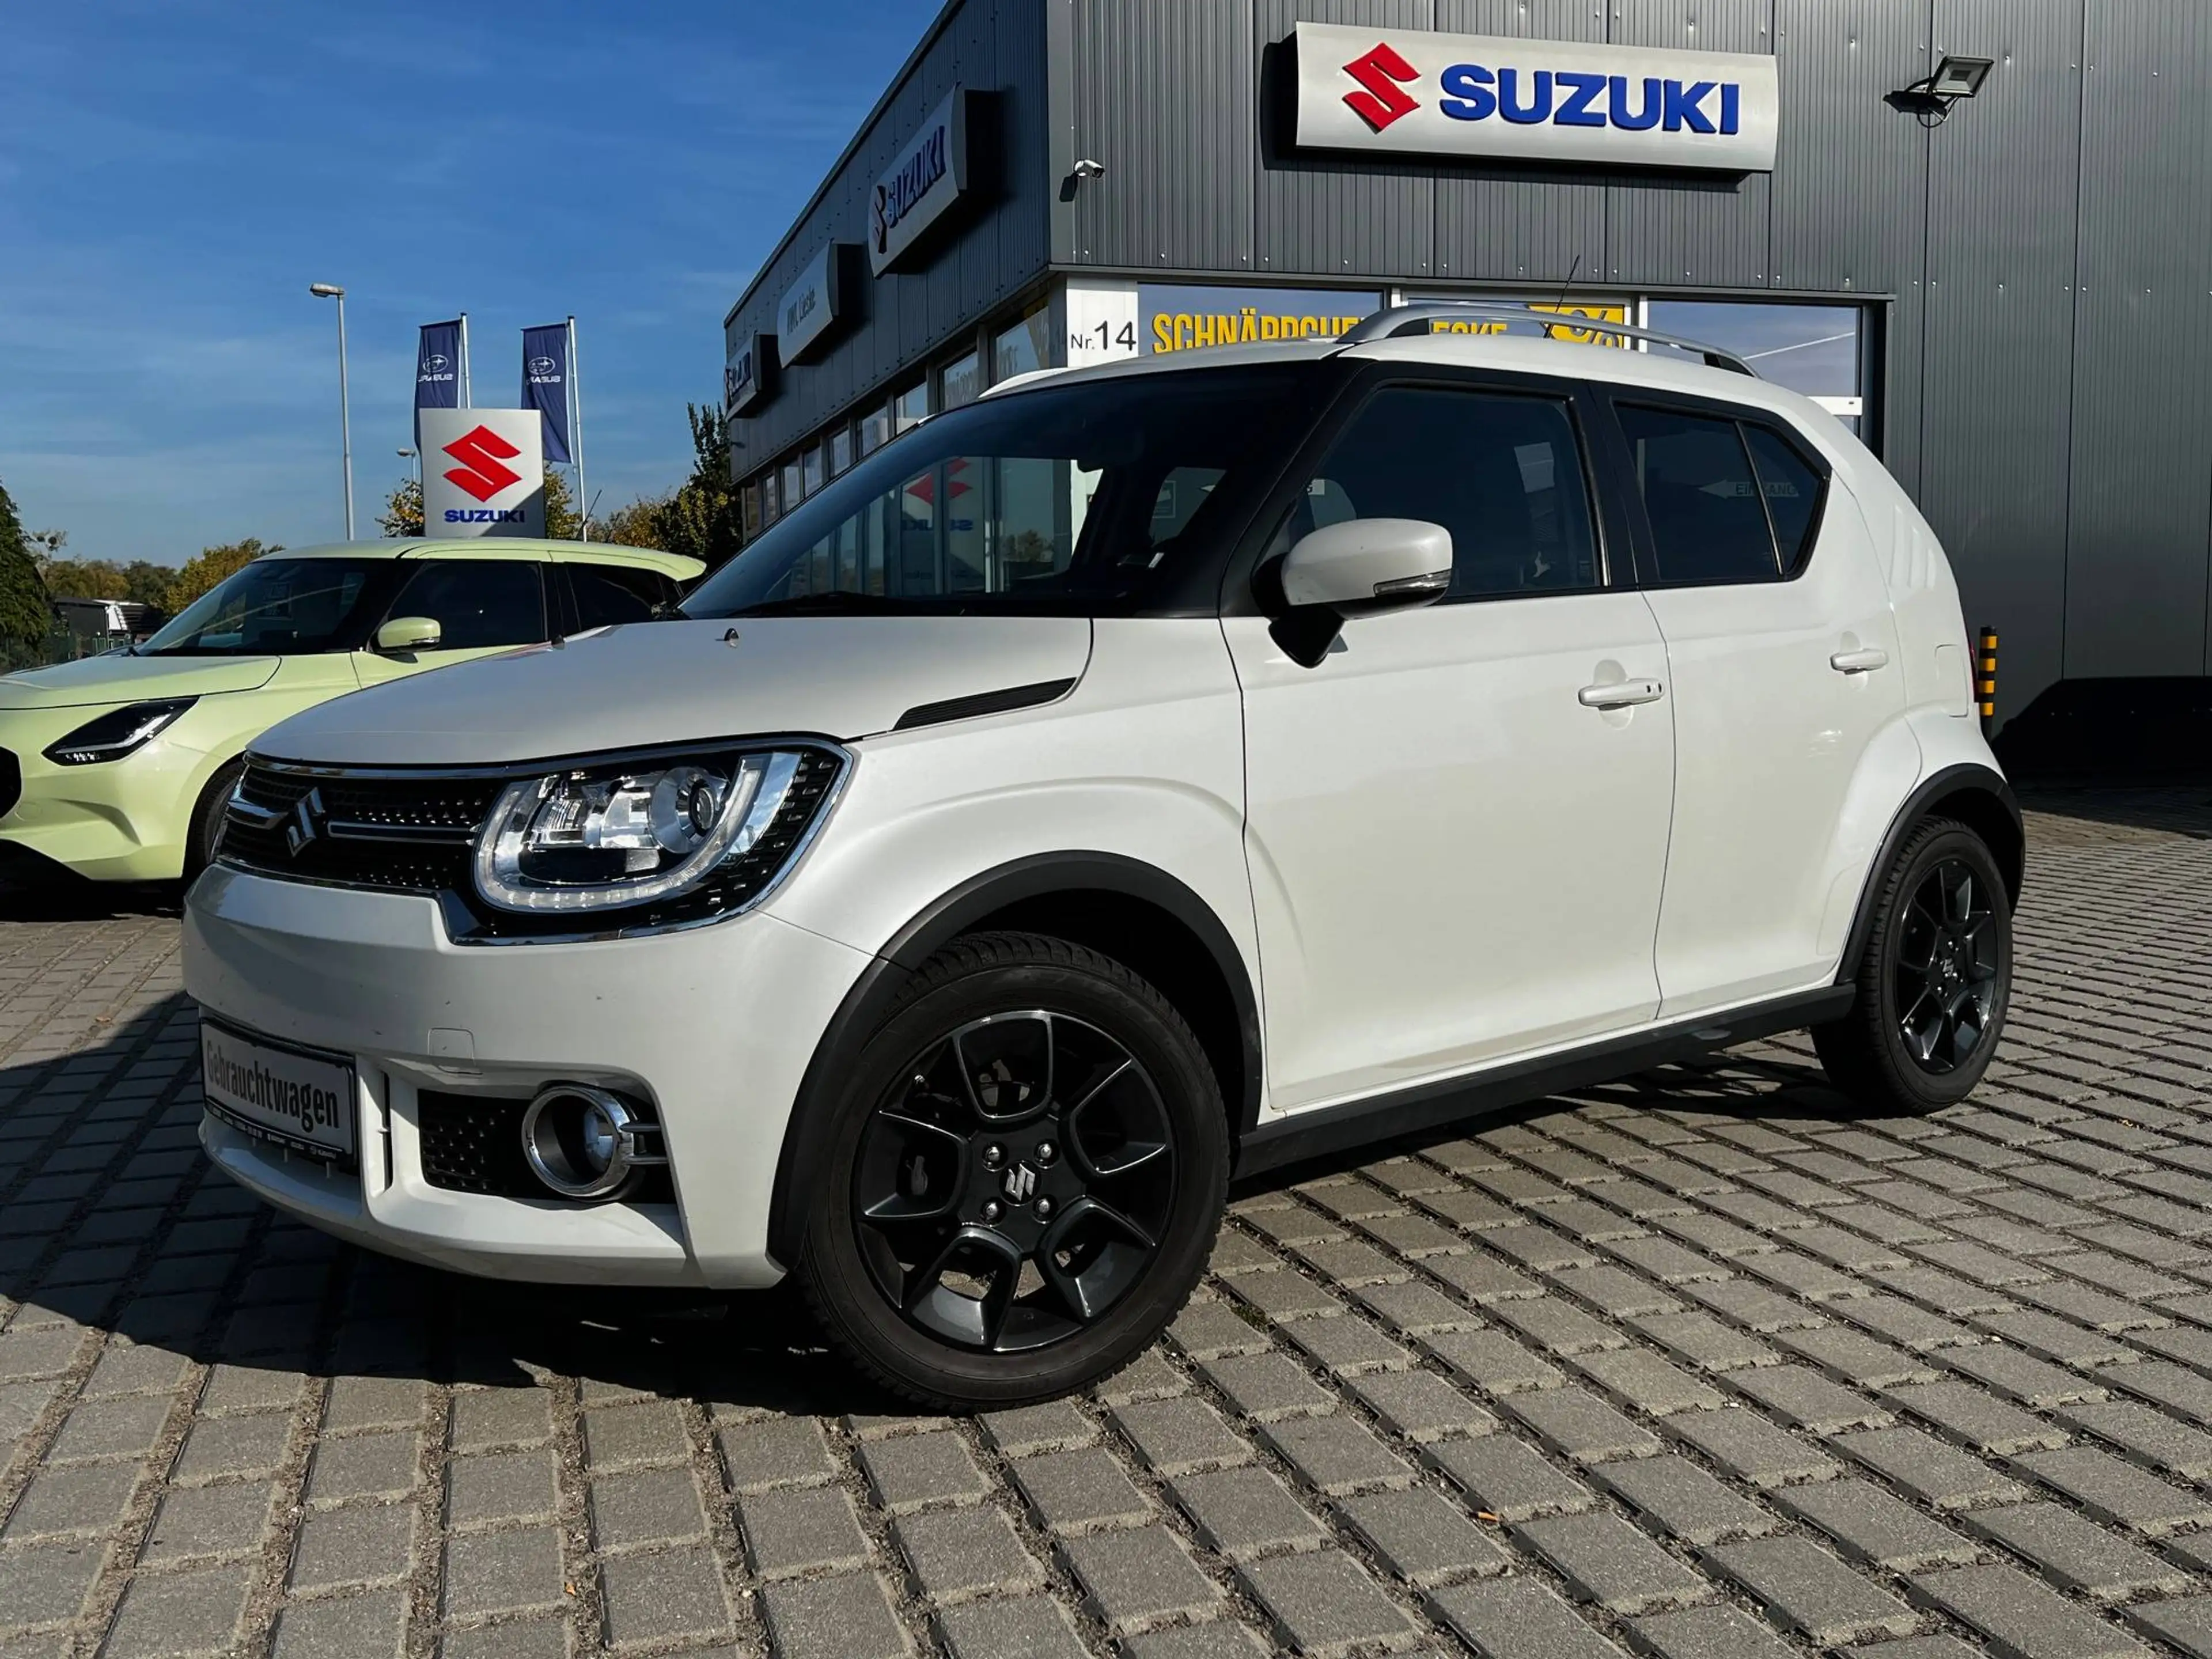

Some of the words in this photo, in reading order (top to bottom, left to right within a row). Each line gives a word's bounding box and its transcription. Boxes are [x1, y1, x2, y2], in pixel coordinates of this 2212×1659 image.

[1440, 63, 1740, 135] SUZUKI
[886, 125, 946, 229] SUZUKI
[444, 509, 525, 524] SUZUKI
[207, 1039, 340, 1133] Gebrauchtwagen
